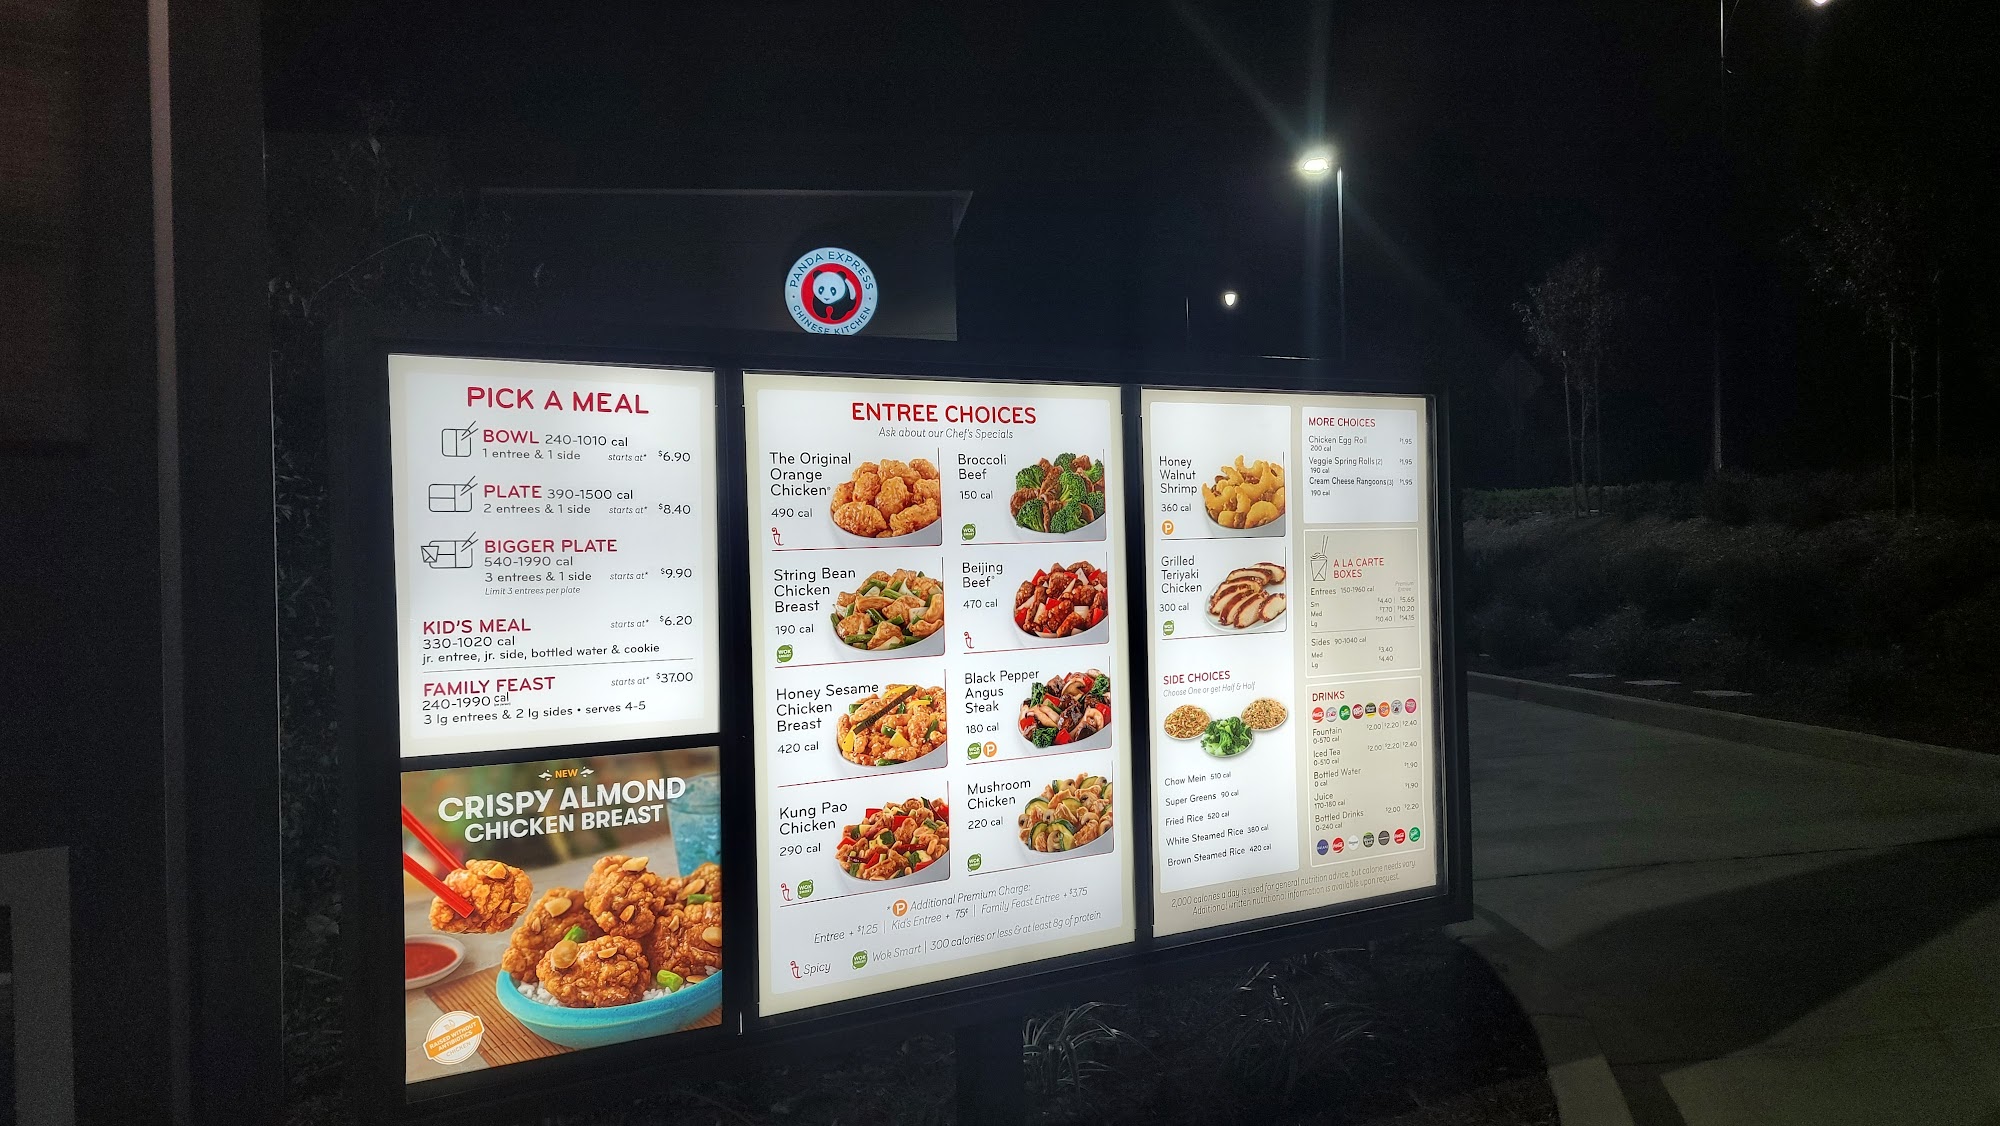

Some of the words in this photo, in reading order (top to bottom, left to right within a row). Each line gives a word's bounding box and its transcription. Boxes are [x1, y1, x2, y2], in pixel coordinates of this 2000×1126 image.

[790, 253, 824, 287] PANDA
[829, 251, 873, 290] EXPRESS
[793, 305, 830, 333] CHINESE
[834, 306, 871, 334] KITCHEN
[467, 386, 534, 409] PICK
[544, 391, 563, 411] A
[573, 392, 649, 414] MEAL
[852, 403, 938, 422] ENTREE
[945, 405, 1037, 424] CHOICES
[1309, 417, 1334, 426] MORE
[1338, 418, 1376, 427] CHOICES
[483, 430, 539, 444] BOWL
[545, 434, 607, 446] 240-1010
[611, 437, 628, 447] cal
[879, 427, 896, 437] Ask
[899, 427, 926, 438] about
[928, 430, 944, 438] our
[946, 428, 972, 440] Chef's
[975, 429, 1014, 440] Specials
[1339, 436, 1351, 445] Egg
[483, 448, 487, 459] 1
[493, 449, 530, 459] entree
[535, 449, 544, 459] &
[548, 449, 552, 459] 1
[557, 449, 580, 460] side
[608, 453, 632, 462] starts
[658, 450, 691, 462] $6.90
[770, 452, 795, 464] The
[800, 452, 851, 467] Original
[958, 454, 1007, 465] Broccoli
[1159, 456, 1192, 468] Honey
[770, 468, 822, 482] Orange
[959, 468, 986, 479] Beef
[1160, 470, 1196, 480] Walnut
[484, 485, 542, 498] PLATE
[547, 489, 612, 500] 390-1500
[617, 490, 633, 500] cal
[960, 491, 977, 499] 150
[980, 490, 993, 499] cal
[1161, 483, 1197, 495] Shrimp
[659, 503, 691, 514] $8.40
[771, 508, 794, 518] 490
[798, 508, 812, 518] cal
[1162, 504, 1178, 512] 360
[1181, 504, 1191, 512] cal
[485, 540, 554, 553] BIGGER
[562, 539, 617, 552] PLATE
[484, 556, 551, 567] 540-1990
[556, 557, 573, 566] cal
[1161, 556, 1194, 566] Grilled
[1334, 559, 1339, 567] A
[1342, 559, 1353, 567] LA
[1356, 558, 1384, 566] CARTE
[661, 568, 692, 579] $9.90
[962, 562, 1003, 574] Beijing
[1334, 570, 1362, 578] BOXES
[774, 569, 815, 582] String
[822, 568, 856, 579] Bean
[1162, 569, 1199, 581] Teriyaki
[485, 587, 505, 595] Limit
[507, 587, 513, 595] 3
[546, 587, 558, 596] per
[561, 585, 580, 596] plate
[774, 584, 830, 597] Chicken
[1162, 583, 1202, 593] Chicken
[775, 600, 819, 612] Breast
[1159, 604, 1176, 612] 300
[423, 620, 472, 635] KID'S
[480, 618, 531, 632] MEAL
[660, 615, 692, 626] $6.20
[423, 637, 492, 650] 330-1020
[497, 636, 515, 646] cal
[422, 654, 434, 665] jr.
[438, 652, 480, 662] entree,
[483, 651, 495, 662] jr.
[500, 650, 527, 660] side,
[532, 647, 572, 658] bottled
[576, 646, 607, 656] water
[612, 645, 620, 654] &
[624, 644, 660, 654] cookie
[656, 672, 693, 684] $37.00
[965, 672, 995, 684] Black
[1000, 670, 1039, 682] Pepper
[1163, 674, 1184, 685] SIDE
[1188, 670, 1231, 683] CHOICES
[424, 680, 489, 696] FAMILY
[496, 677, 555, 692] FEAST
[777, 688, 821, 701] Honey
[826, 684, 879, 696] Sesame
[965, 688, 1003, 700] Angus
[1312, 691, 1345, 701] DRINKS
[422, 696, 490, 711] 240-1990
[494, 692, 509, 703] cal
[777, 702, 832, 716] Chicken
[966, 702, 999, 714] Steak
[778, 718, 822, 732] Breast
[1313, 727, 1342, 736] Fountain
[555, 769, 578, 779] NEW
[1314, 770, 1338, 779] Bottled
[1341, 768, 1361, 776] Water
[1165, 777, 1186, 786] Chow
[1188, 774, 1206, 783] Mein
[968, 780, 1031, 795] Mushroom
[438, 787, 555, 822] CRISPY
[559, 777, 686, 811] ALMOND
[968, 795, 1016, 810] Chicken
[1166, 797, 1188, 807] Super
[1189, 792, 1216, 802] Greens
[1314, 793, 1333, 801] Juice
[780, 806, 816, 819] Kung
[822, 802, 848, 814] Pao
[465, 814, 574, 842] CHICKEN
[581, 804, 664, 831] BREAST
[1166, 816, 1184, 826] Fried
[1186, 814, 1203, 823] Rice
[780, 819, 836, 835] Chicken
[1166, 835, 1189, 846] White
[1192, 829, 1225, 843] Steamed
[1228, 827, 1243, 837] Rice
[1167, 856, 1191, 866] Brown
[1194, 850, 1227, 862] Steamed
[1230, 847, 1245, 856] Rice
[910, 893, 956, 912] Additional
[958, 890, 996, 904] Premium
[999, 884, 1031, 896] Charge:
[873, 948, 891, 961] Wok
[894, 944, 921, 957] Smart
[803, 962, 831, 976] Spicy
